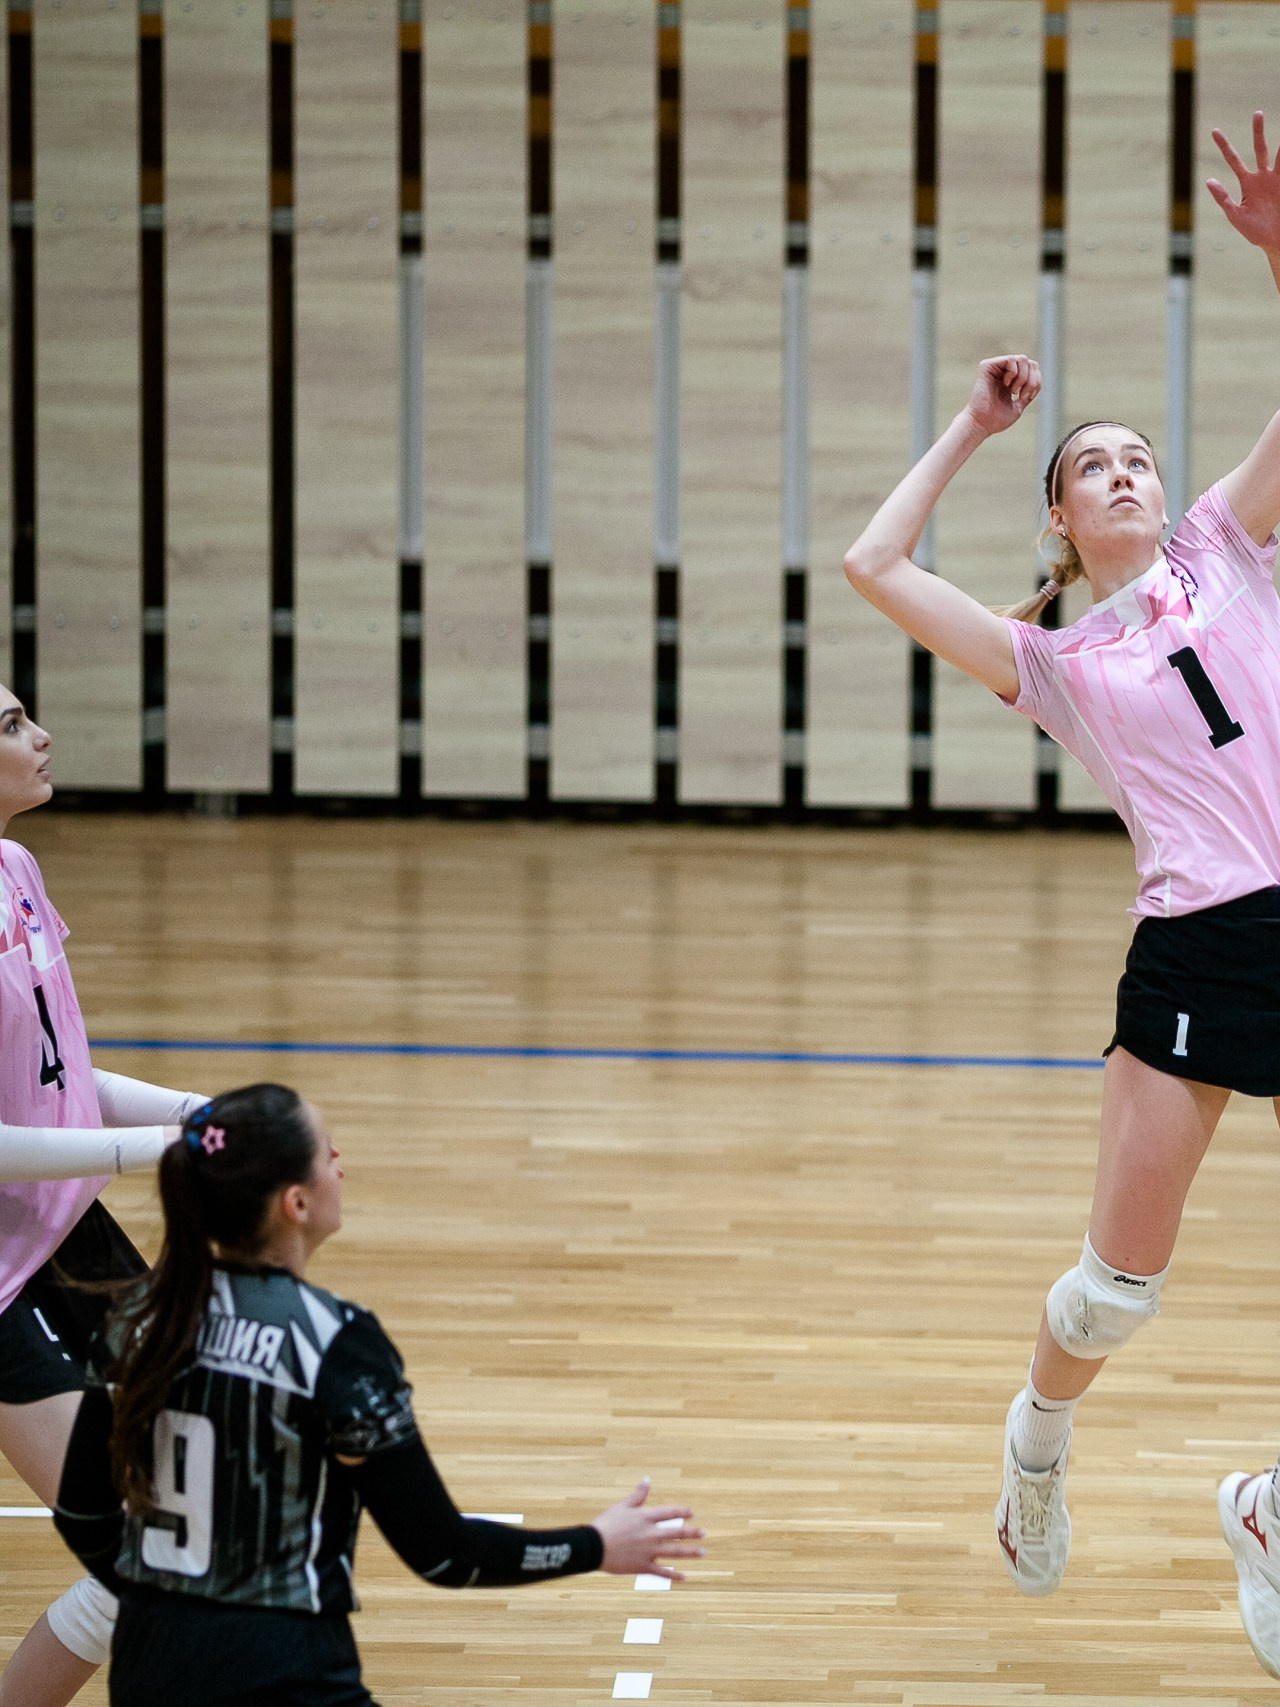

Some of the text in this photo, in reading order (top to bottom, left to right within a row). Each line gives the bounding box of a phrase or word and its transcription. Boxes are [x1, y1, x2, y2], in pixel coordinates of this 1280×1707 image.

[1166, 646, 1245, 750] 1
[33, 983, 66, 1092] 4
[1172, 1012, 1190, 1056] 1
[141, 1408, 216, 1577] 9
